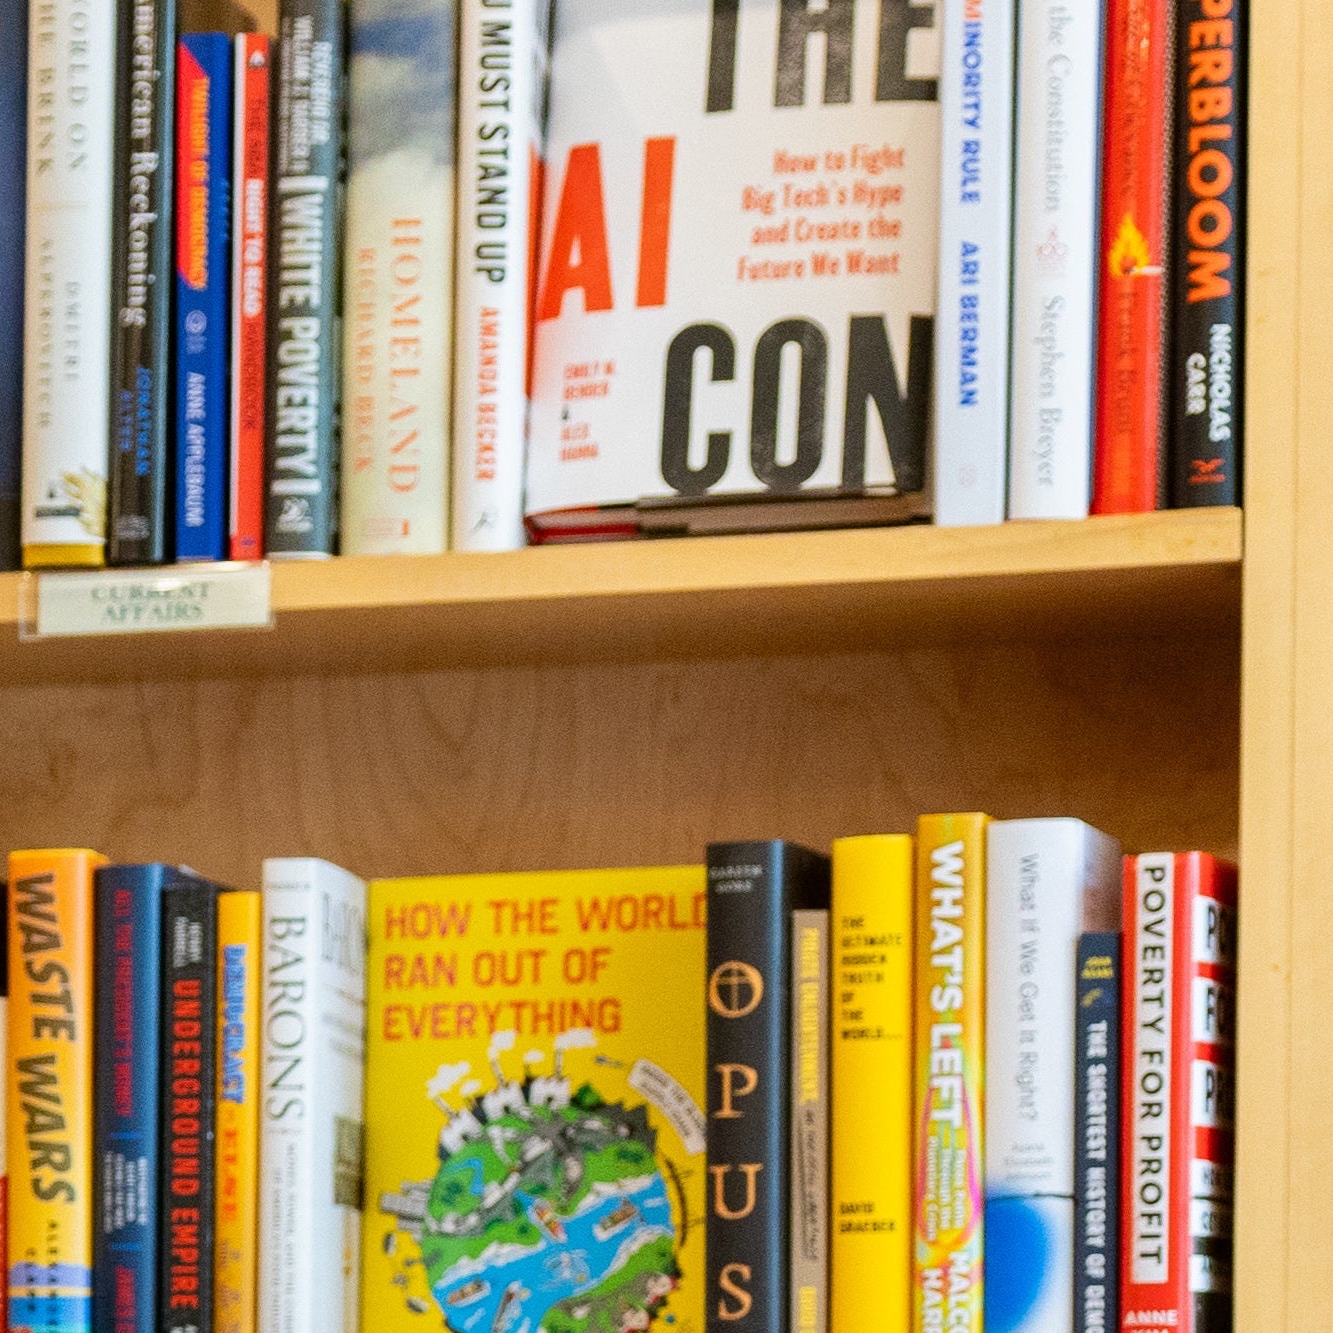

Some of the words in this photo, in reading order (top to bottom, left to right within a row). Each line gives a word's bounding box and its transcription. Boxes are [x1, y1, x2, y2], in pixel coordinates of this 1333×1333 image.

[477, 19, 512, 111] MUST
[477, 122, 510, 231] STAND
[741, 188, 773, 214] Big
[783, 183, 845, 208] Tech's
[854, 184, 903, 208] Hype
[774, 150, 816, 173] How
[825, 148, 845, 170] to
[852, 146, 904, 174] Fight
[960, 139, 980, 205] RULE
[281, 195, 324, 306] WHITE
[475, 241, 508, 284] UP
[535, 136, 675, 322] AI
[737, 257, 803, 281] Future
[811, 253, 840, 276] We
[847, 253, 900, 274] Want
[751, 221, 789, 244] and
[794, 218, 860, 241] Create
[868, 216, 900, 238] the
[961, 240, 980, 286] ARI
[277, 312, 321, 478] POVERTY
[389, 216, 421, 494] HOMELAND
[961, 292, 978, 406] BERMAN
[1186, 353, 1205, 413] CARR
[1208, 322, 1232, 444] NICHOLAS
[659, 315, 936, 497] CON
[91, 581, 213, 601] CURRENT
[101, 602, 203, 622] AFFAIRS
[12, 870, 78, 1042] WASTE
[385, 902, 471, 940] HOW
[490, 898, 560, 936] THE
[385, 952, 457, 989] RAN
[473, 949, 546, 986] OUT
[563, 946, 611, 984] OF
[929, 839, 965, 1012] WHAT'S
[1144, 865, 1166, 1036] POVERTY
[269, 916, 310, 1122] BARONS
[382, 998, 622, 1041] EVERYTHING
[169, 979, 199, 1195] UNDERGROUND
[930, 1021, 962, 1127] LEFT
[1141, 1049, 1164, 1118] FOR
[16, 1054, 78, 1204] WARS
[1137, 1127, 1163, 1266] PROFIT
[169, 1204, 199, 1308] EMPIRE
